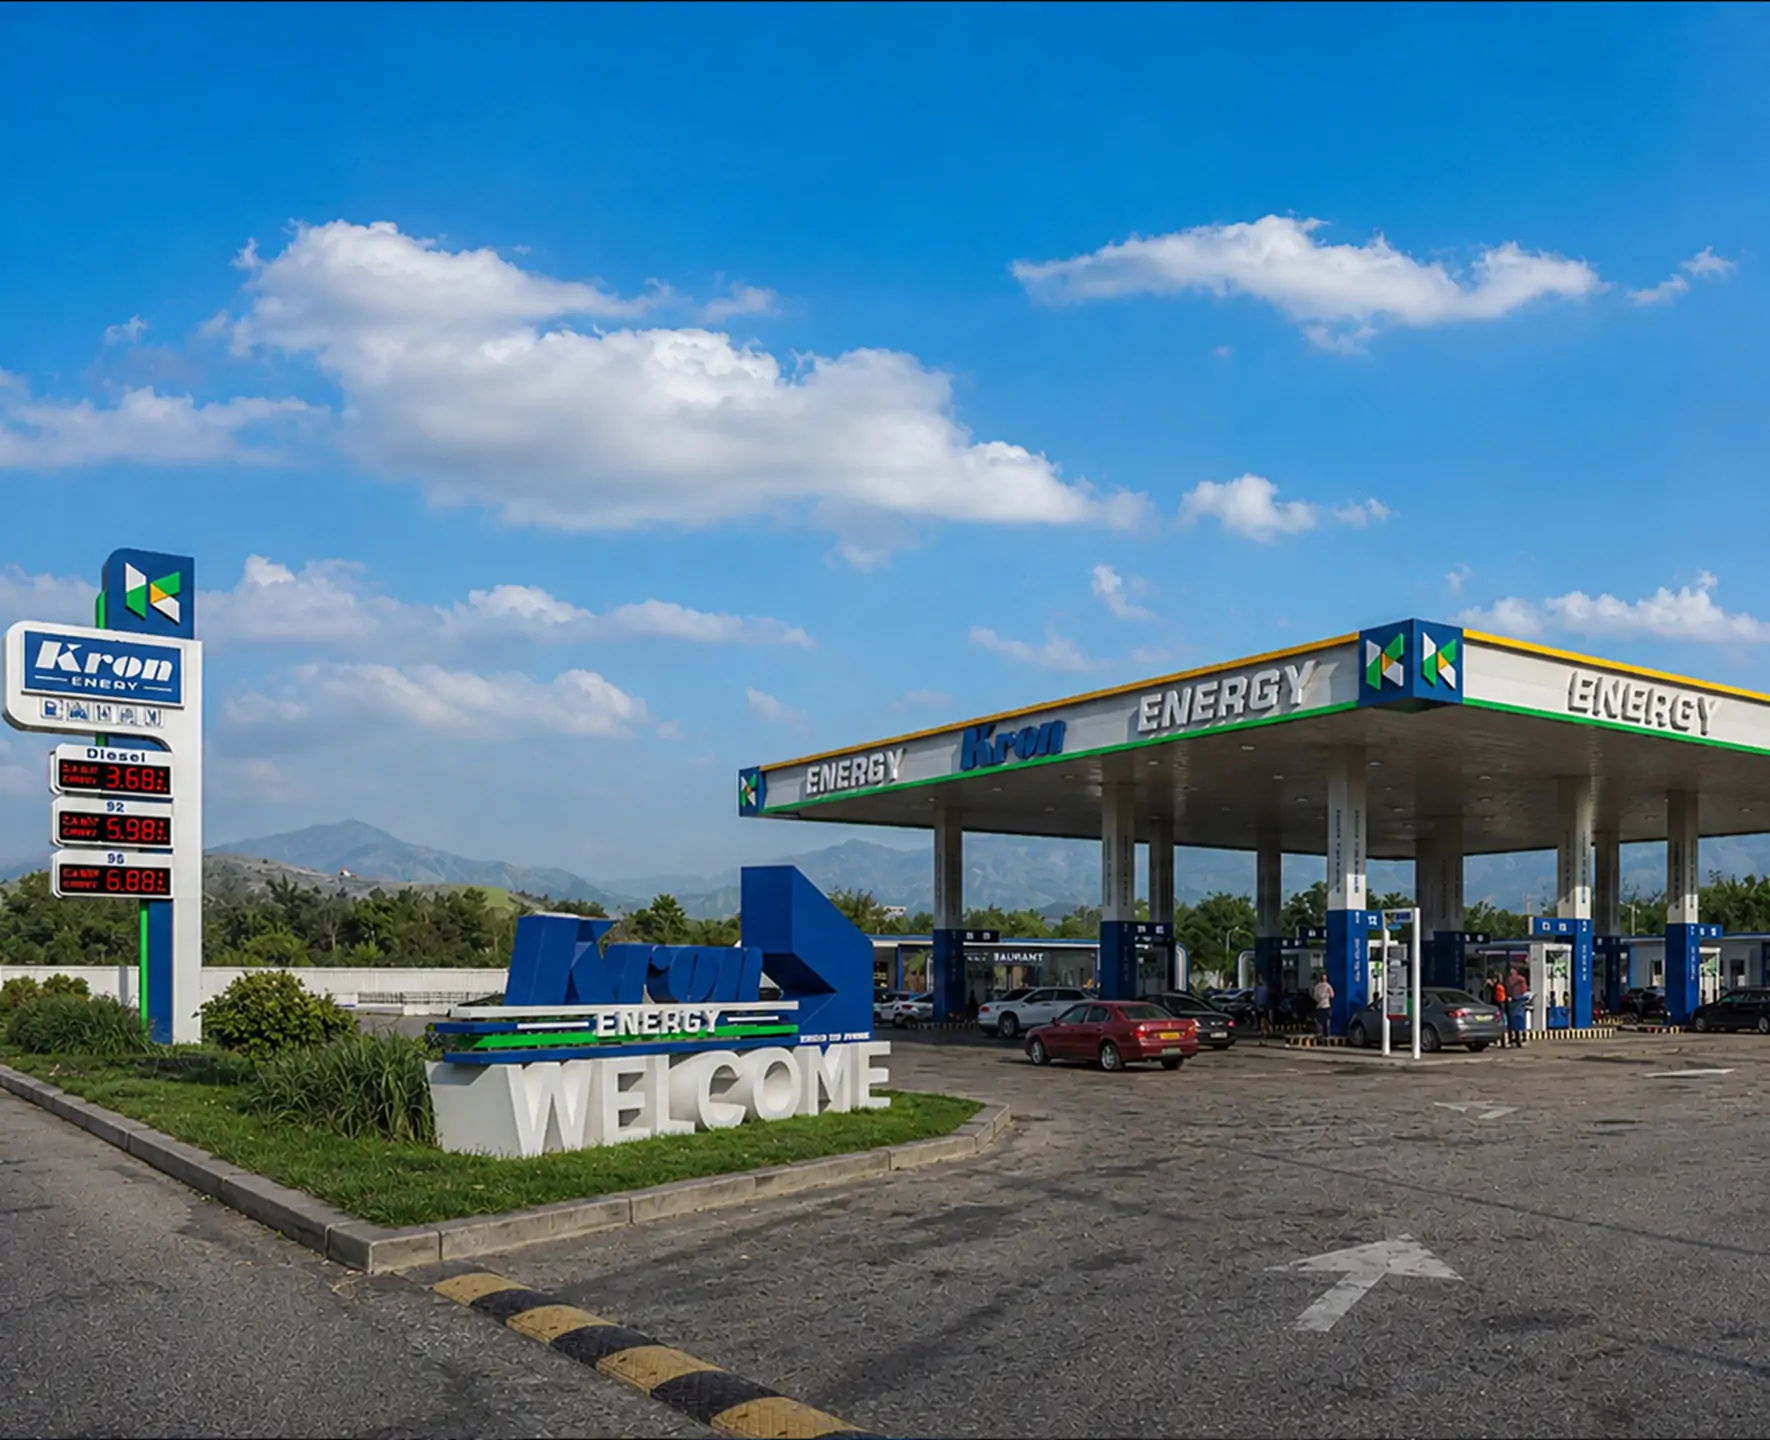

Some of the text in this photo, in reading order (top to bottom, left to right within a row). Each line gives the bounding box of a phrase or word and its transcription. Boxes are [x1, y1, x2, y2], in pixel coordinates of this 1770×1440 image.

[35, 640, 173, 682] Kron
[1137, 659, 1320, 733] ENERGY
[1567, 671, 1722, 736] ENERGY
[960, 719, 1067, 771] Kron
[805, 748, 905, 794] ENERGY
[106, 801, 125, 813] 92
[596, 1007, 722, 1037] ENERGY
[505, 1041, 891, 1157] WELCOME
